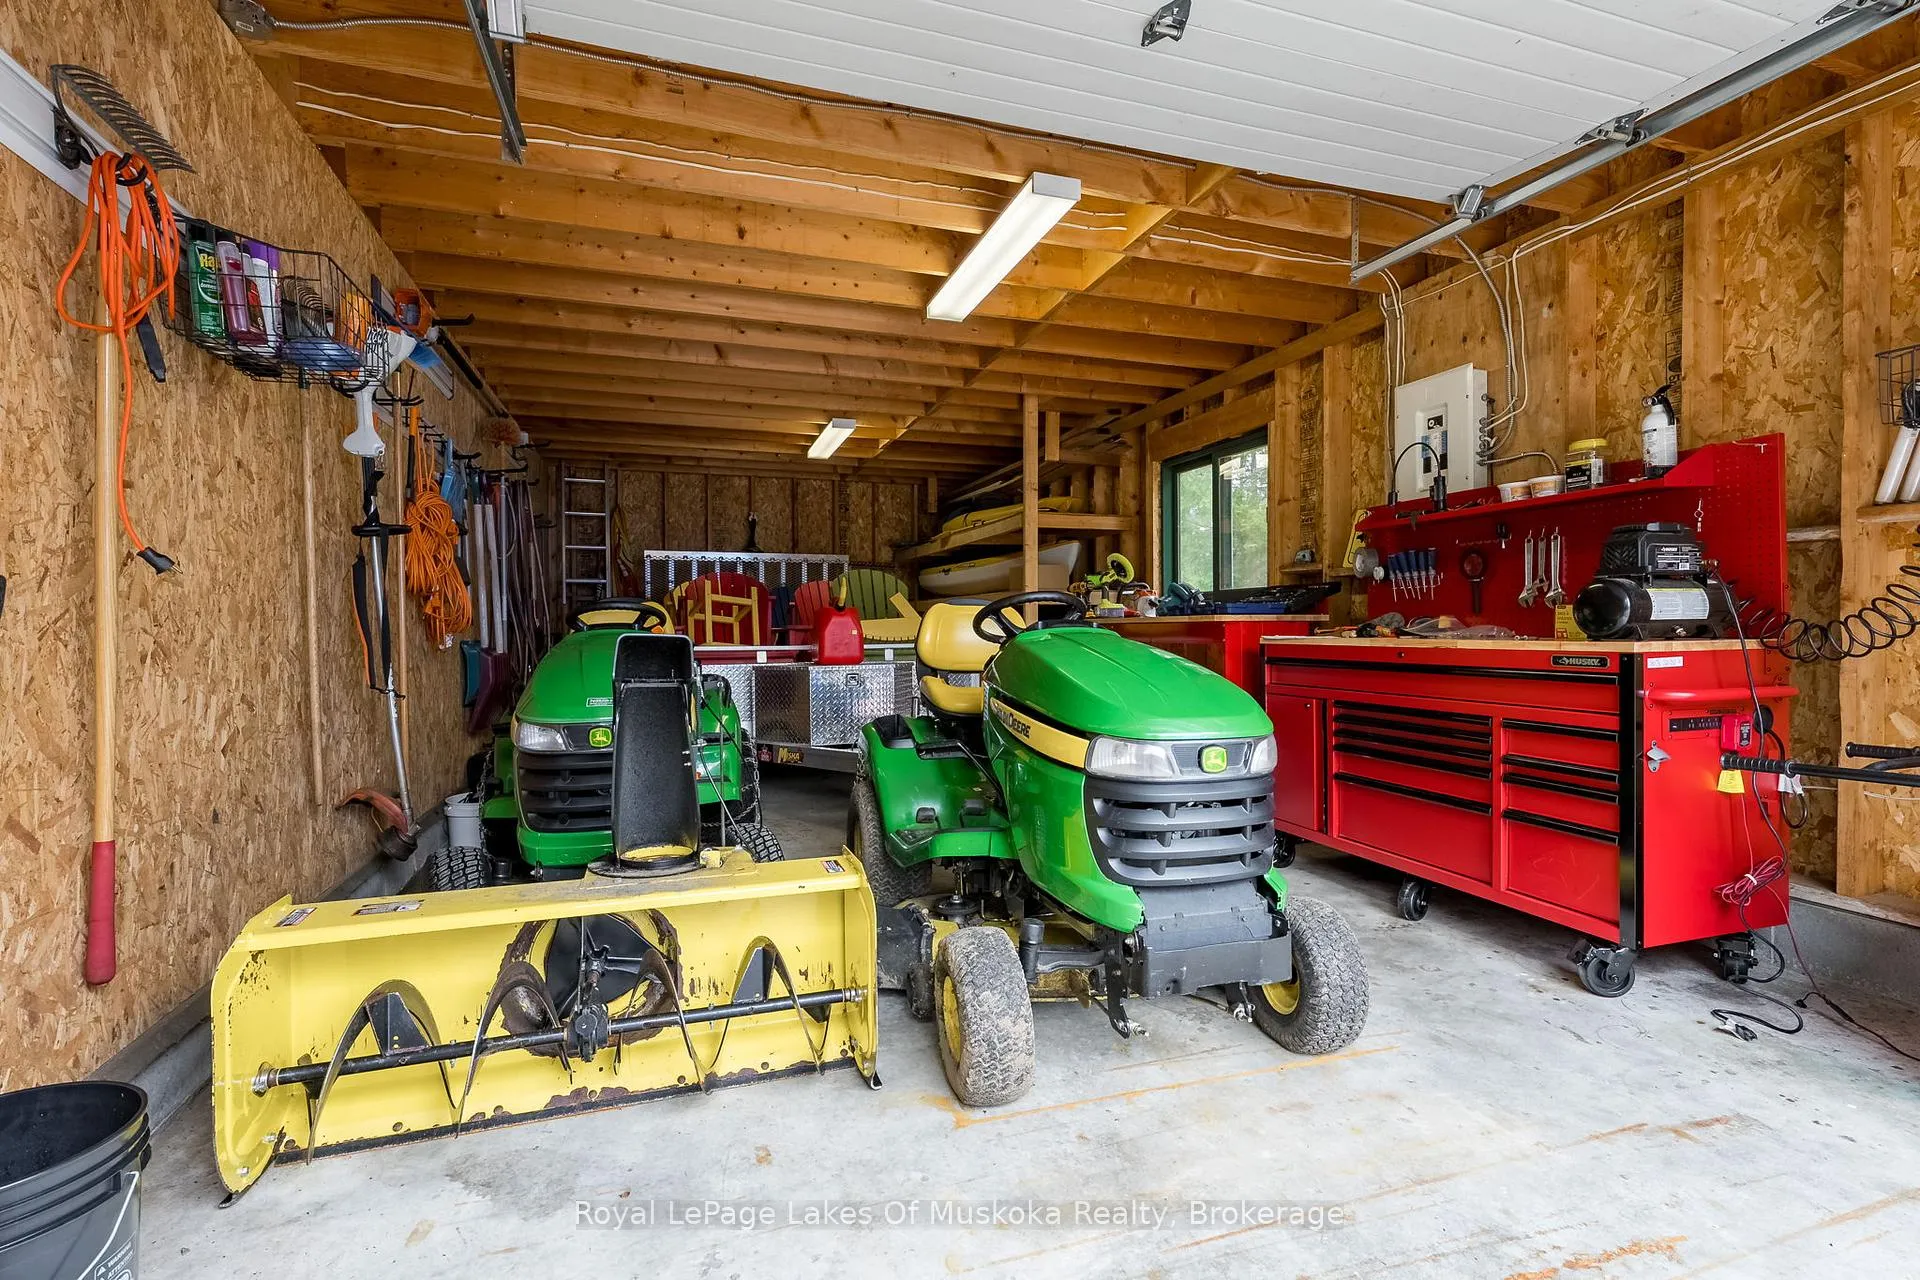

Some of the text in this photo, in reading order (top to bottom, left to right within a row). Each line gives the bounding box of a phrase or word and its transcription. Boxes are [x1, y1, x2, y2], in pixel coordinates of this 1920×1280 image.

[200, 253, 221, 270] Ra
[1569, 657, 1601, 666] HUSKY
[1007, 711, 1031, 739] DEERE
